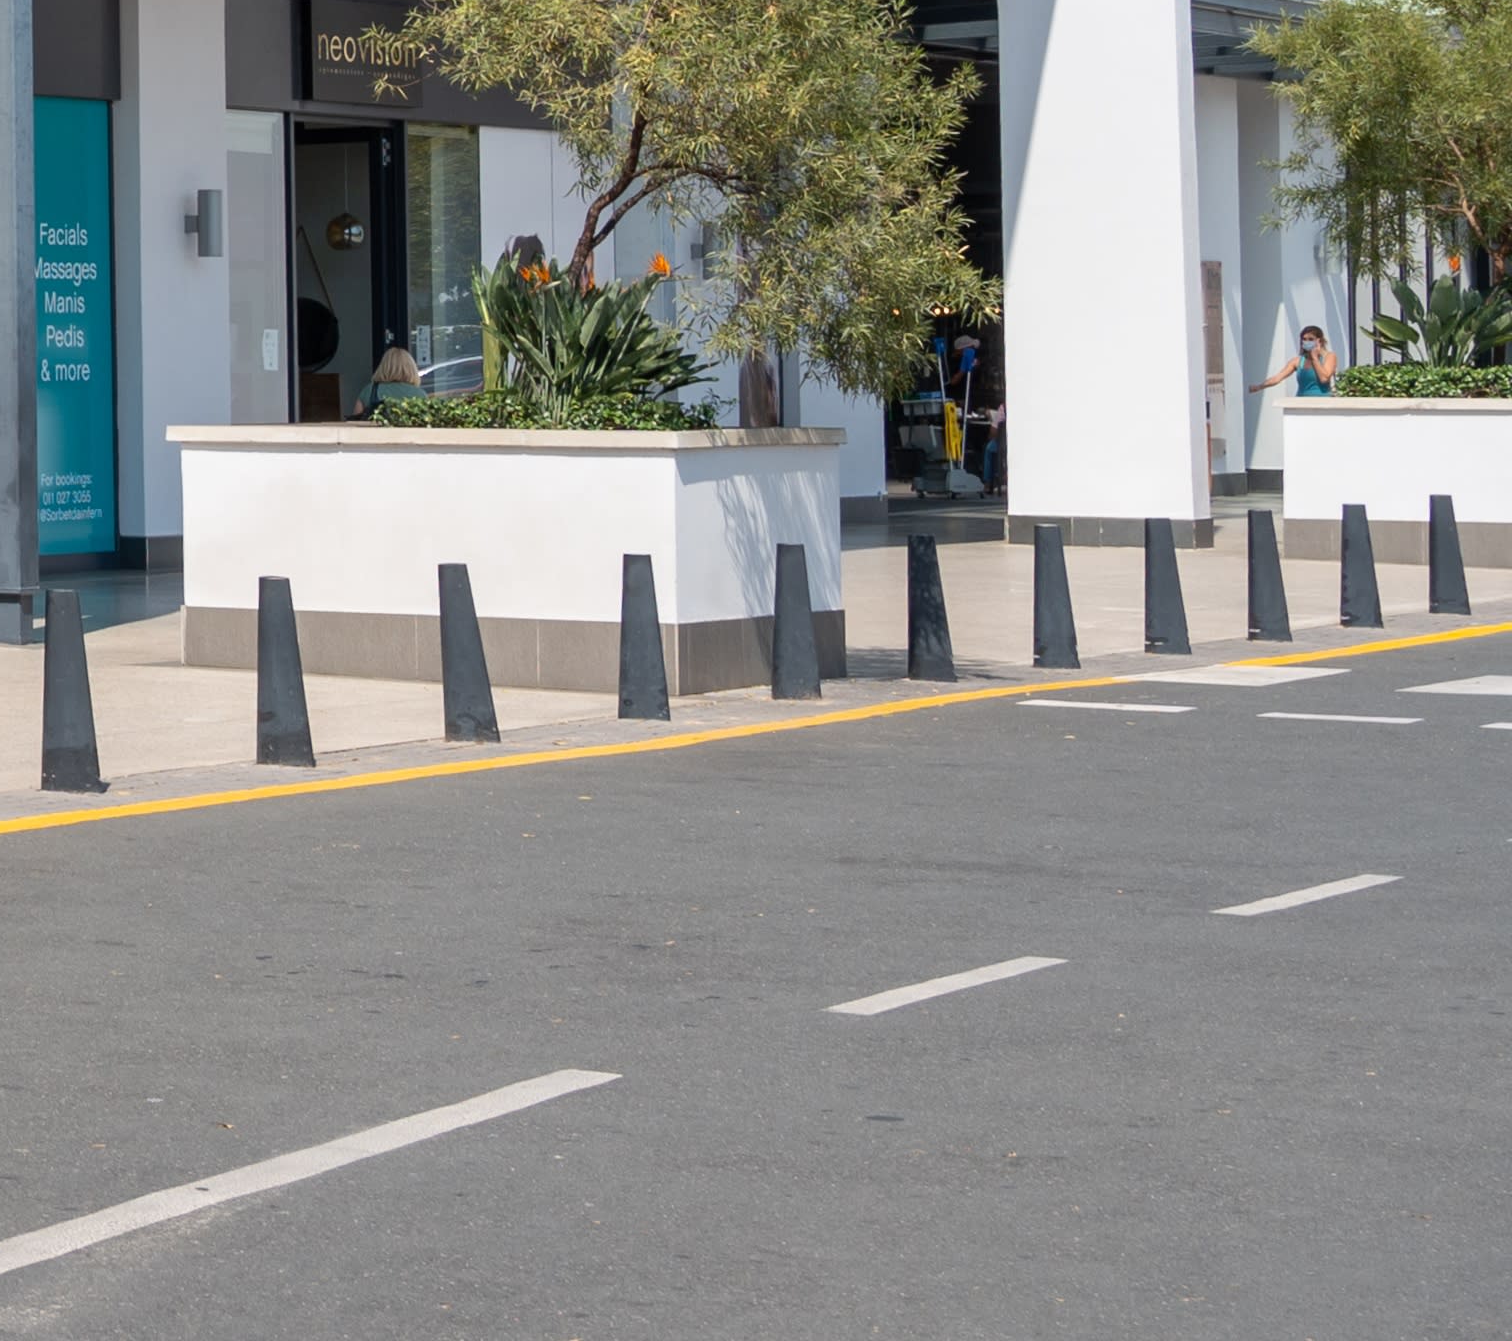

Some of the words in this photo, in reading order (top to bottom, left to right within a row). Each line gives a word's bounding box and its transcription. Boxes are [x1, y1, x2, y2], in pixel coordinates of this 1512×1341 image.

[39, 222, 88, 247] Facials
[44, 290, 85, 315] Manis
[45, 323, 85, 349] Pedis
[40, 359, 51, 382] &
[54, 363, 91, 383] more
[40, 473, 54, 486] For
[55, 472, 93, 488] bookings:
[42, 491, 55, 505] 011
[56, 490, 71, 504] 027
